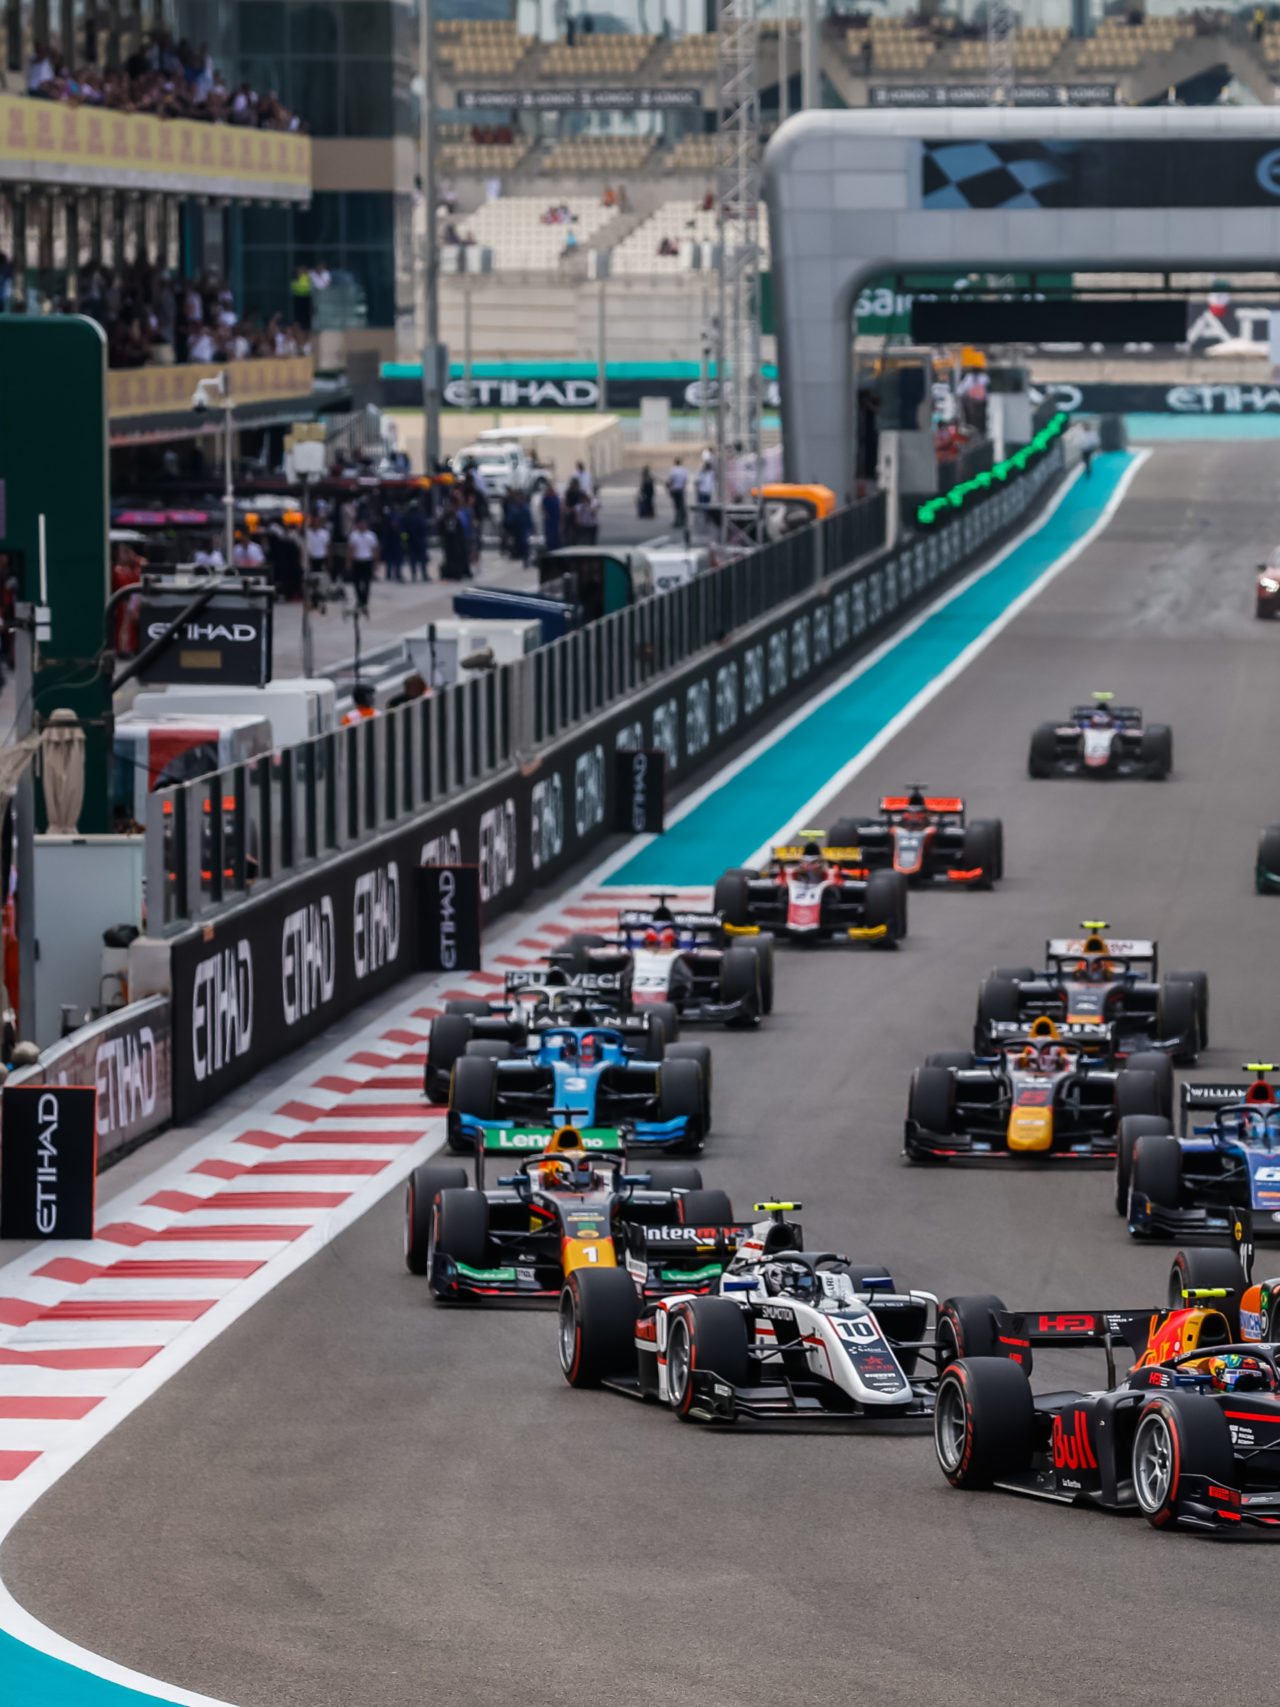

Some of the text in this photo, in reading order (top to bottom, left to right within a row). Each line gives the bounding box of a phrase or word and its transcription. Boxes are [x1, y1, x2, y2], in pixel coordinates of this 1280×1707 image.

[444, 379, 599, 406] ETIHAD
[353, 861, 400, 979] ETIHAD
[438, 869, 457, 969] ETIHAD
[281, 895, 336, 1026] ETIHAD
[192, 938, 254, 1082] ETIHAD
[536, 1015, 641, 1026] ALNE
[95, 1026, 157, 1136] ETIHAD
[564, 1077, 586, 1092] 3
[1191, 1087, 1247, 1098] WILLIAM
[36, 1093, 58, 1233] ETIHAD
[583, 1246, 599, 1263] 1
[837, 1322, 876, 1338] 10
[1052, 1410, 1098, 1469] Bull
